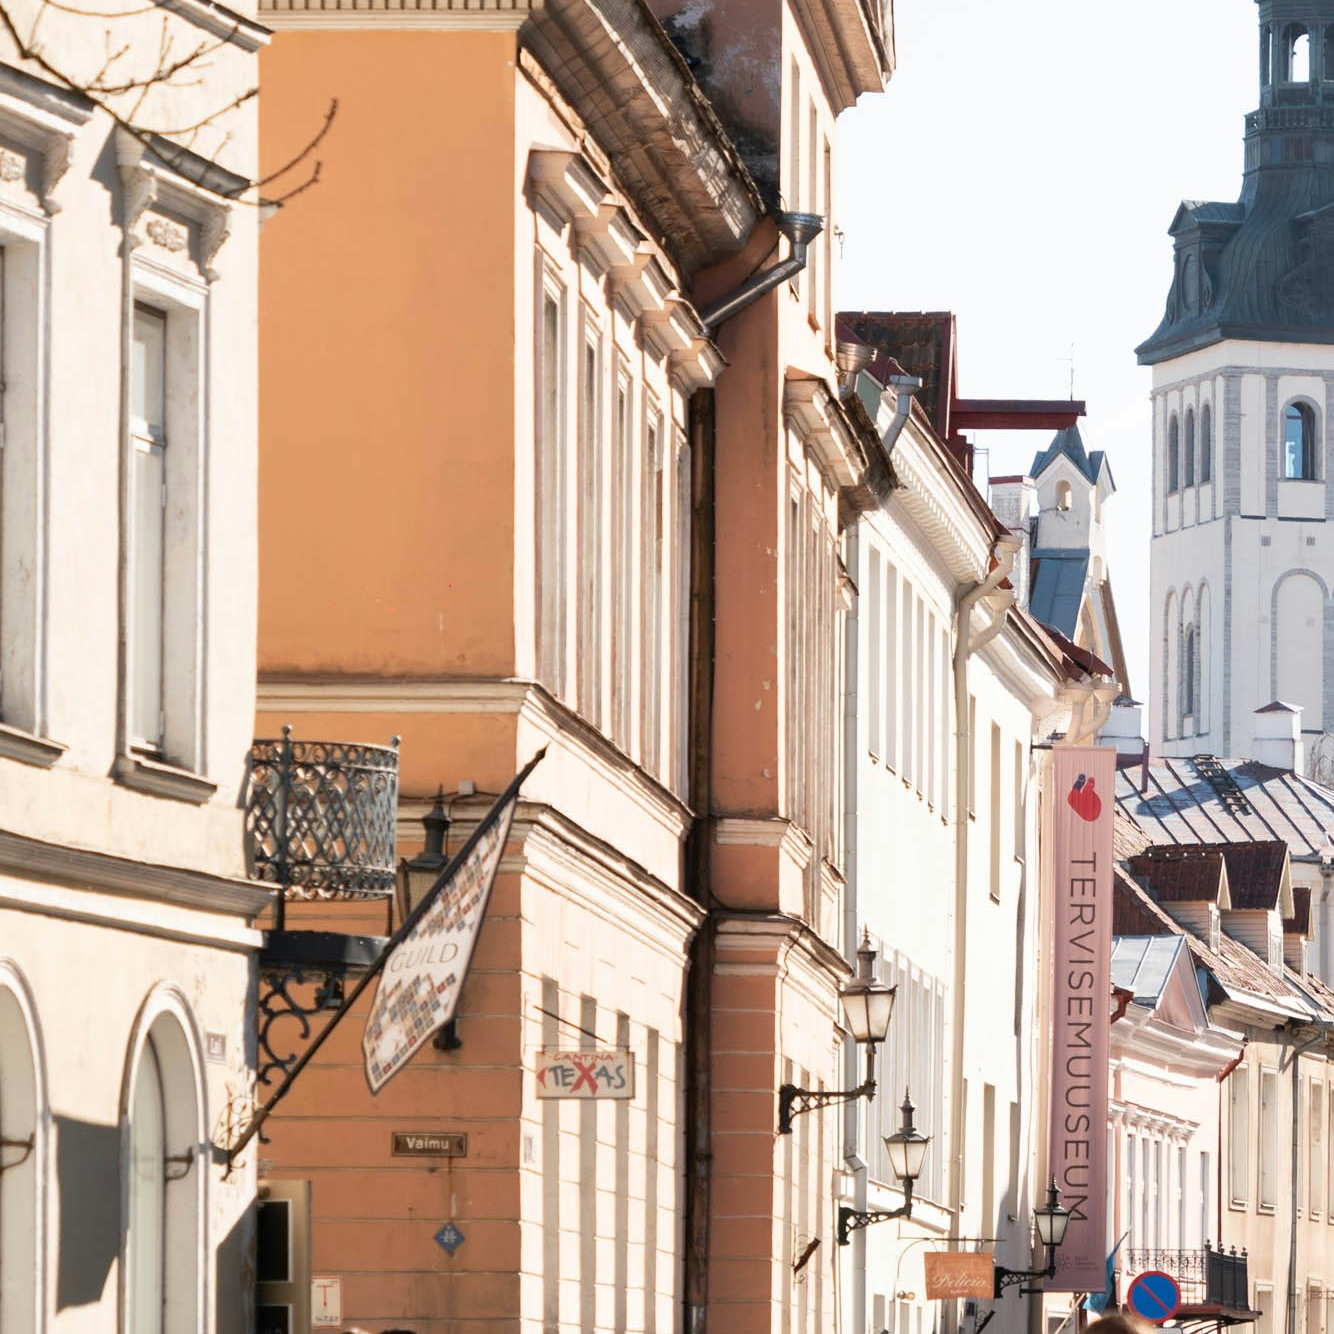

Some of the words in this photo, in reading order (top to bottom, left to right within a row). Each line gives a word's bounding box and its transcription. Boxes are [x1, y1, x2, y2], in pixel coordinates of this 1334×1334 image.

[390, 942, 459, 973] GUILD
[1063, 851, 1097, 1222] TERVISEMUUSEUM
[553, 1053, 614, 1061] CANTINA
[548, 1061, 626, 1096] TEXAS
[406, 1136, 450, 1150] Vaimu
